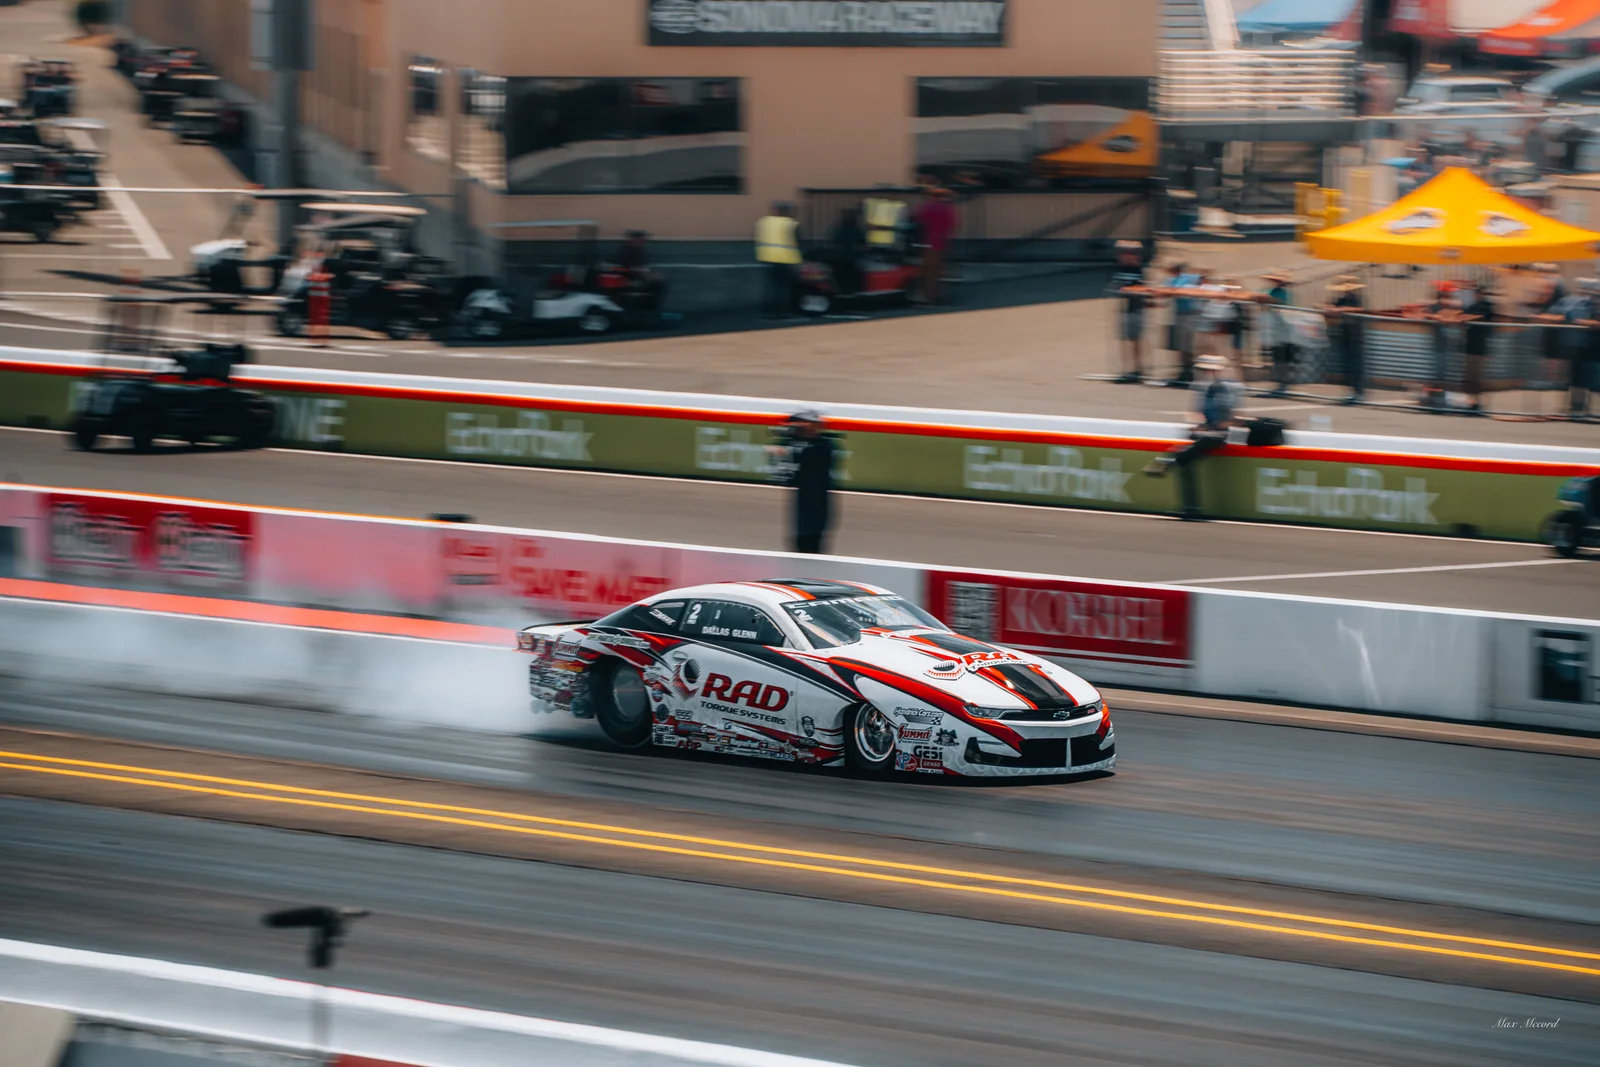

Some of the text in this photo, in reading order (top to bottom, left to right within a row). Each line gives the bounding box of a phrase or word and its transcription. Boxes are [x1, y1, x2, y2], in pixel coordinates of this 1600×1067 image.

[845, 2, 1003, 34] RACEWAY
[691, 603, 702, 620] 2
[702, 626, 757, 639] DALLAS GLENN
[701, 672, 789, 712] RAD
[700, 700, 786, 725] TORQUE SYSTEMS
[898, 725, 931, 741] SUMMIT
